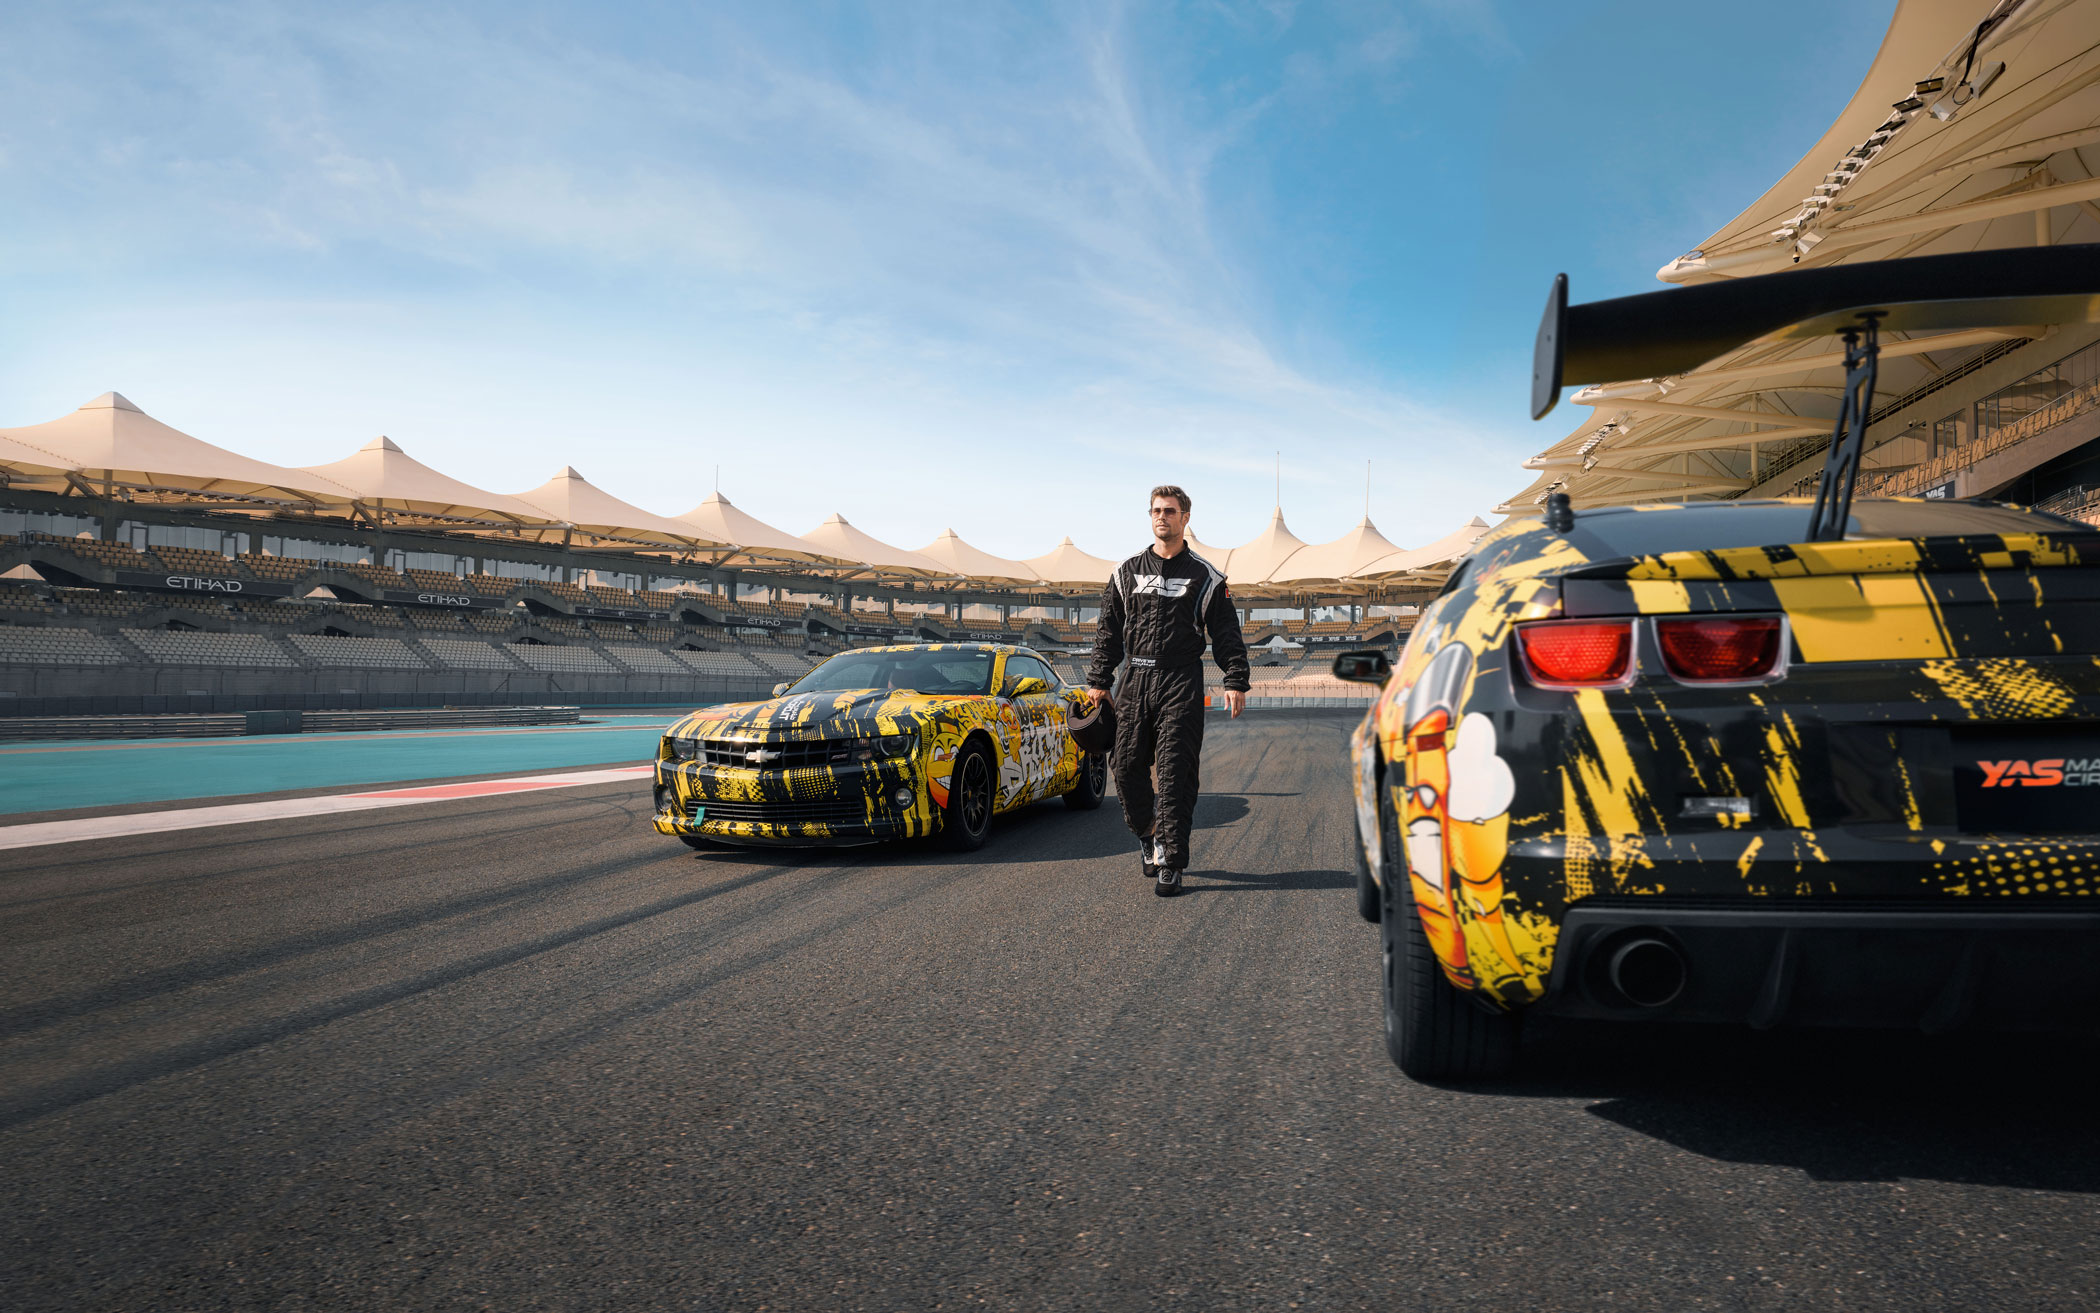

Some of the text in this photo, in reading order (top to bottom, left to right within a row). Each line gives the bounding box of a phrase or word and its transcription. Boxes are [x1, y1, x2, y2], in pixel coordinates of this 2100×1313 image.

[1925, 485, 1946, 498] YAS
[166, 576, 242, 592] ETIHAD
[1132, 574, 1191, 597] YAS
[418, 594, 470, 606] ETIHAD
[747, 617, 781, 626] ETIHAD
[970, 632, 1002, 640] ETIHAD
[1976, 759, 2065, 788] YAS
